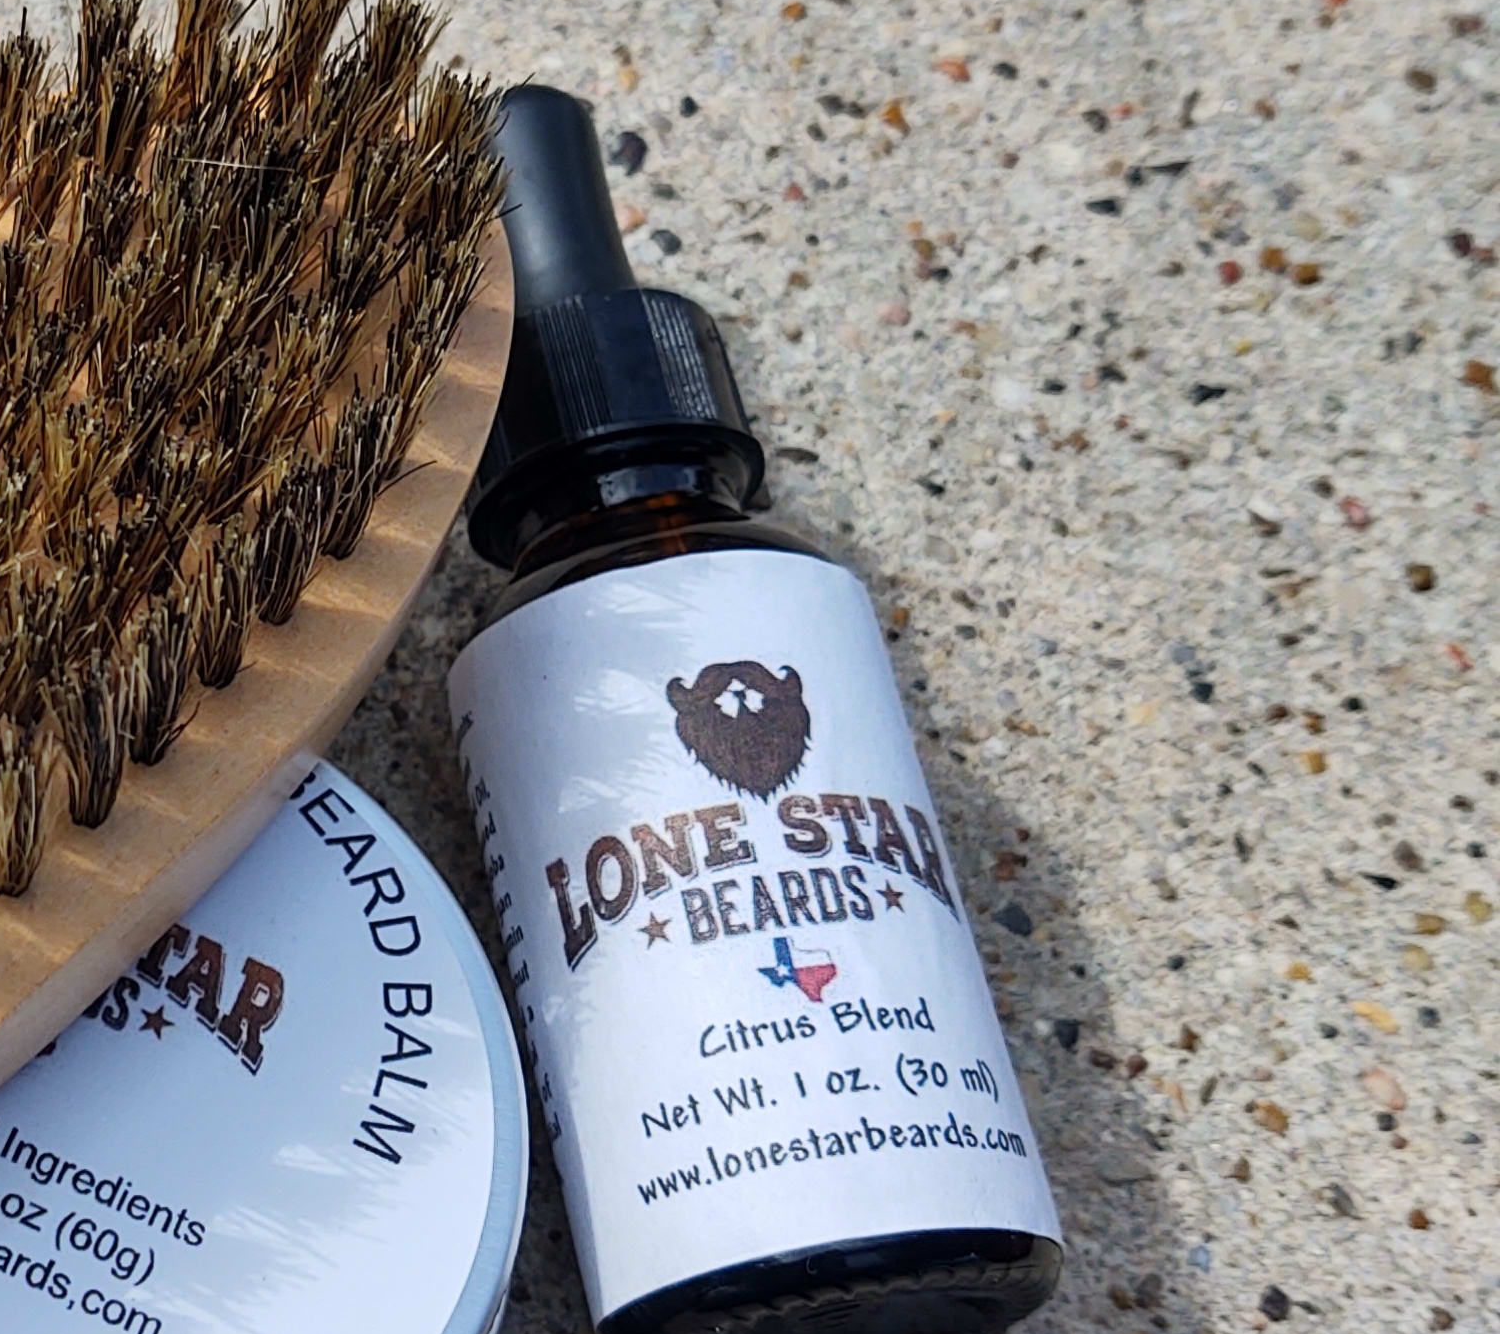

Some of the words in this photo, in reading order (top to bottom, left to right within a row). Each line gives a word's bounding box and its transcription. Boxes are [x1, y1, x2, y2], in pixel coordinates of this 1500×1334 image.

[545, 802, 757, 972] LONE
[680, 864, 875, 945] BEARDS
[136, 923, 285, 1077] TAR
[700, 1013, 816, 1059] Citrus
[830, 996, 936, 1034] Blend
[353, 982, 432, 1165] BALM
[641, 1094, 702, 1138] Net
[713, 1076, 778, 1117] Wt.
[795, 1071, 807, 1098] 1
[825, 1066, 881, 1094] oz.
[895, 1053, 949, 1096] (30
[960, 1058, 1000, 1103] ml)
[0, 1127, 206, 1247] Ingredients
[637, 1112, 1028, 1206] www.lonestarbeards.com
[0, 1192, 48, 1232] oz
[55, 1211, 155, 1287] (60g)
